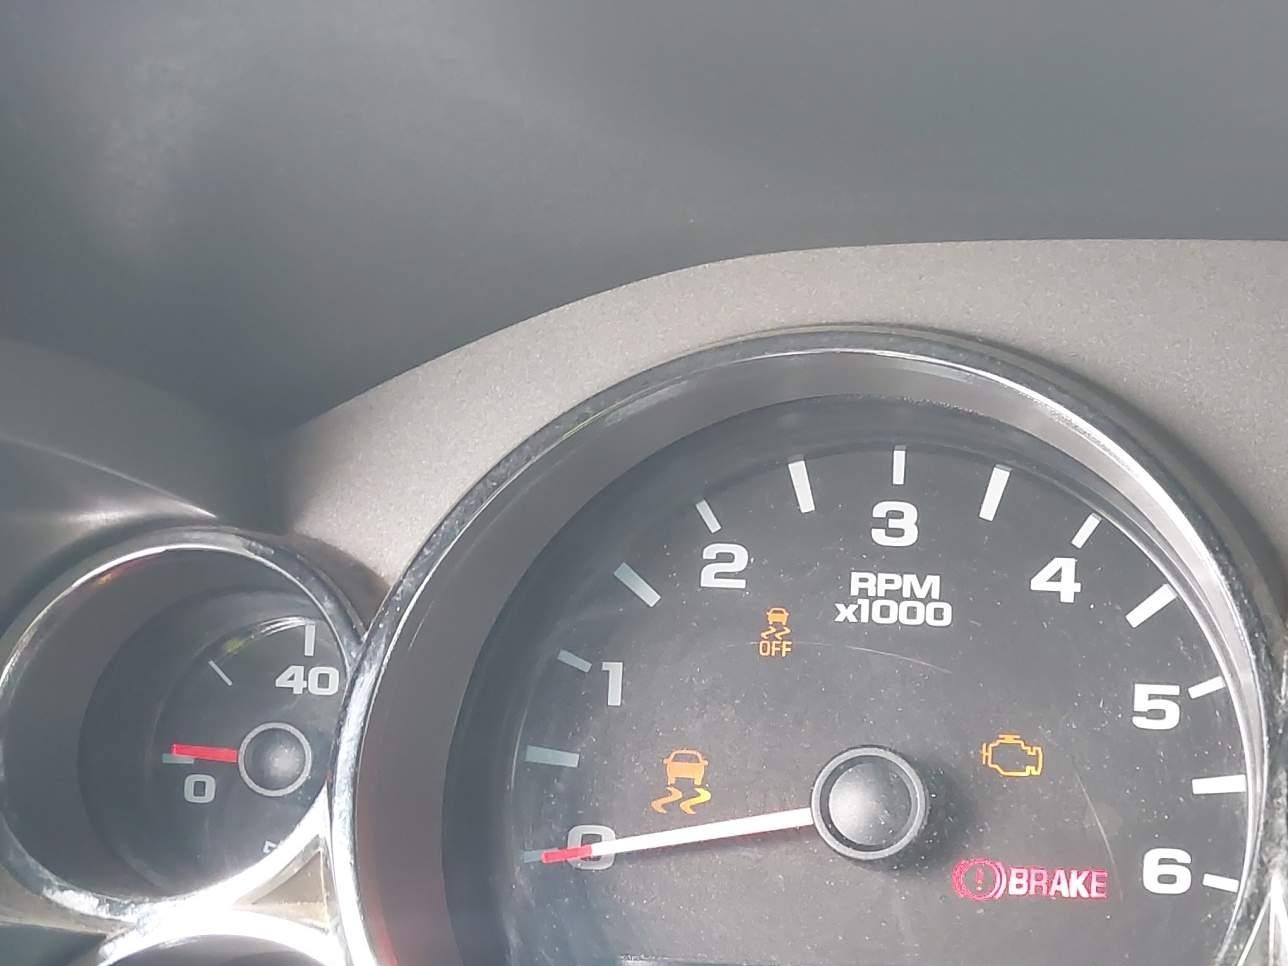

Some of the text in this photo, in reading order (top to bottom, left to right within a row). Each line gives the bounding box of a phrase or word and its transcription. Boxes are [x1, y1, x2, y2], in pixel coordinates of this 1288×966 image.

[871, 501, 919, 547] 3
[701, 544, 748, 589] 2
[850, 572, 942, 598] RPM
[1030, 557, 1081, 603] 4
[833, 600, 953, 628] x1000
[758, 640, 792, 658] OFF
[275, 665, 340, 696] 40
[601, 662, 624, 707] 1
[1131, 683, 1180, 730] 5
[183, 774, 217, 804] 0
[567, 824, 616, 870] 0
[1007, 867, 1108, 899] BRAKE
[1142, 848, 1193, 895] 6
